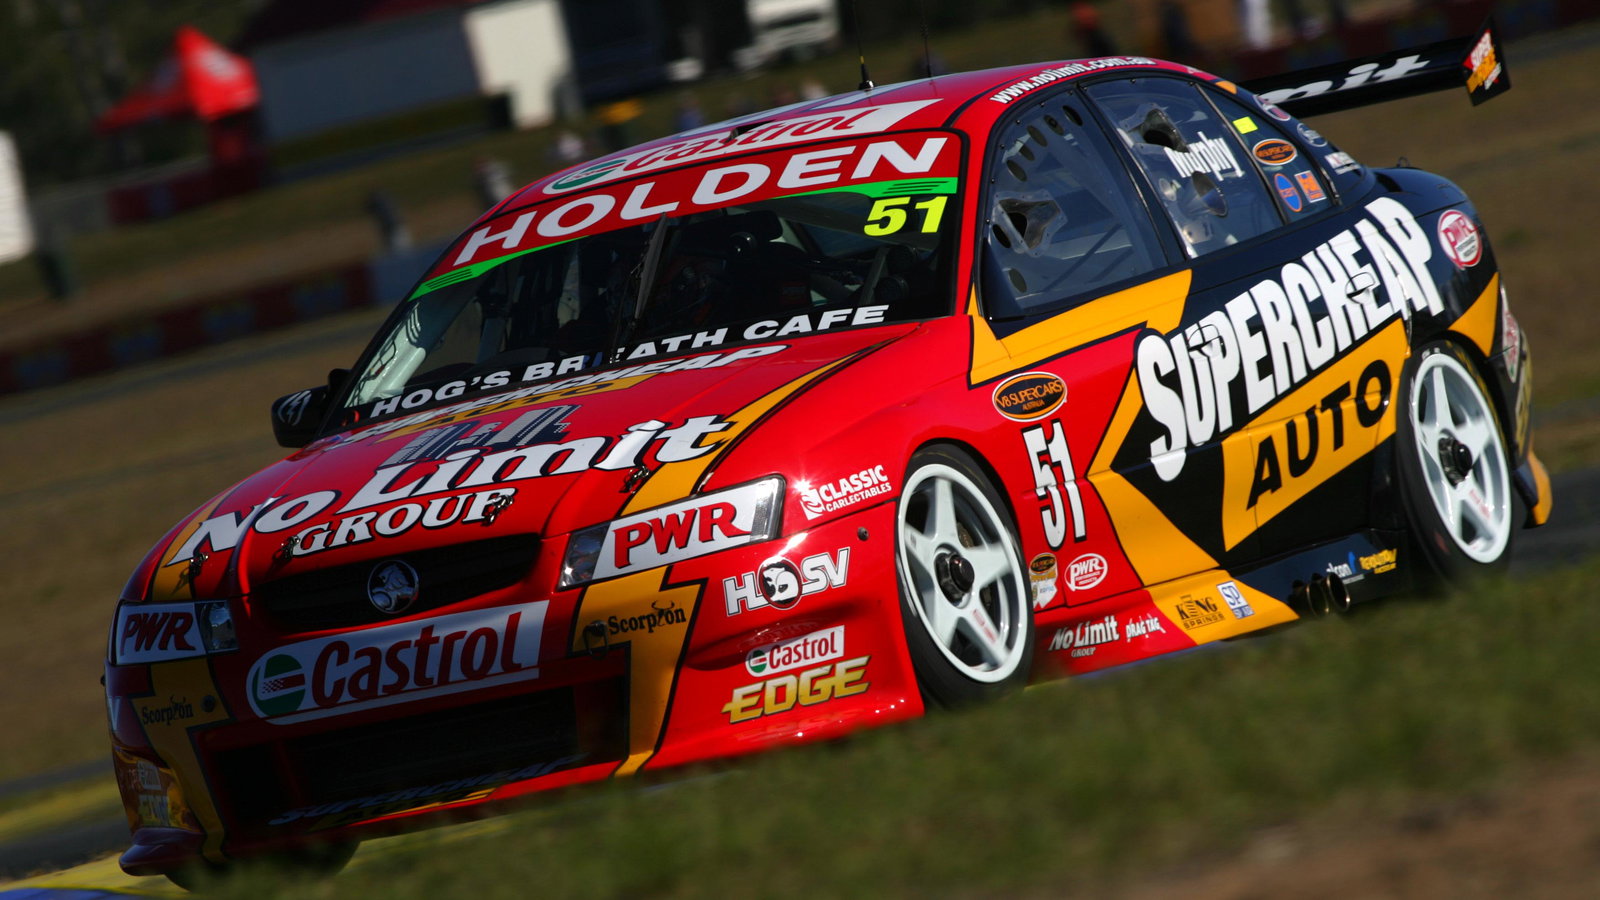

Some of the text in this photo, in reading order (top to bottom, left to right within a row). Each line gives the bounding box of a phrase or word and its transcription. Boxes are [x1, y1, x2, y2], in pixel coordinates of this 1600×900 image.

[990, 56, 1156, 104] www.nolimit.com.au
[623, 108, 882, 172] Castrol
[1163, 131, 1244, 181] Murphy
[453, 136, 949, 266] HOLDEN
[863, 195, 948, 238] 51
[370, 370, 510, 419] HOG'S
[743, 304, 889, 341] CAFE
[1137, 197, 1446, 482] SUPERCHEAP
[996, 379, 1064, 408] V8 SUPERCARS
[1246, 358, 1392, 511] AUTO
[166, 413, 738, 567] No Limit
[819, 464, 889, 502] CLASSIC
[825, 481, 892, 513] CARLECTABLES
[1020, 418, 1090, 552] 51
[290, 486, 517, 559] GROUP
[612, 501, 755, 568] PWR
[1070, 557, 1104, 591] PWR
[120, 611, 197, 656] PWR
[607, 602, 687, 634] Scorpion
[1048, 614, 1120, 652] No Limit
[1183, 613, 1226, 630] SPRINGS
[310, 610, 524, 710] Castrol
[768, 631, 838, 670] Castrol
[721, 655, 871, 724] EDGE
